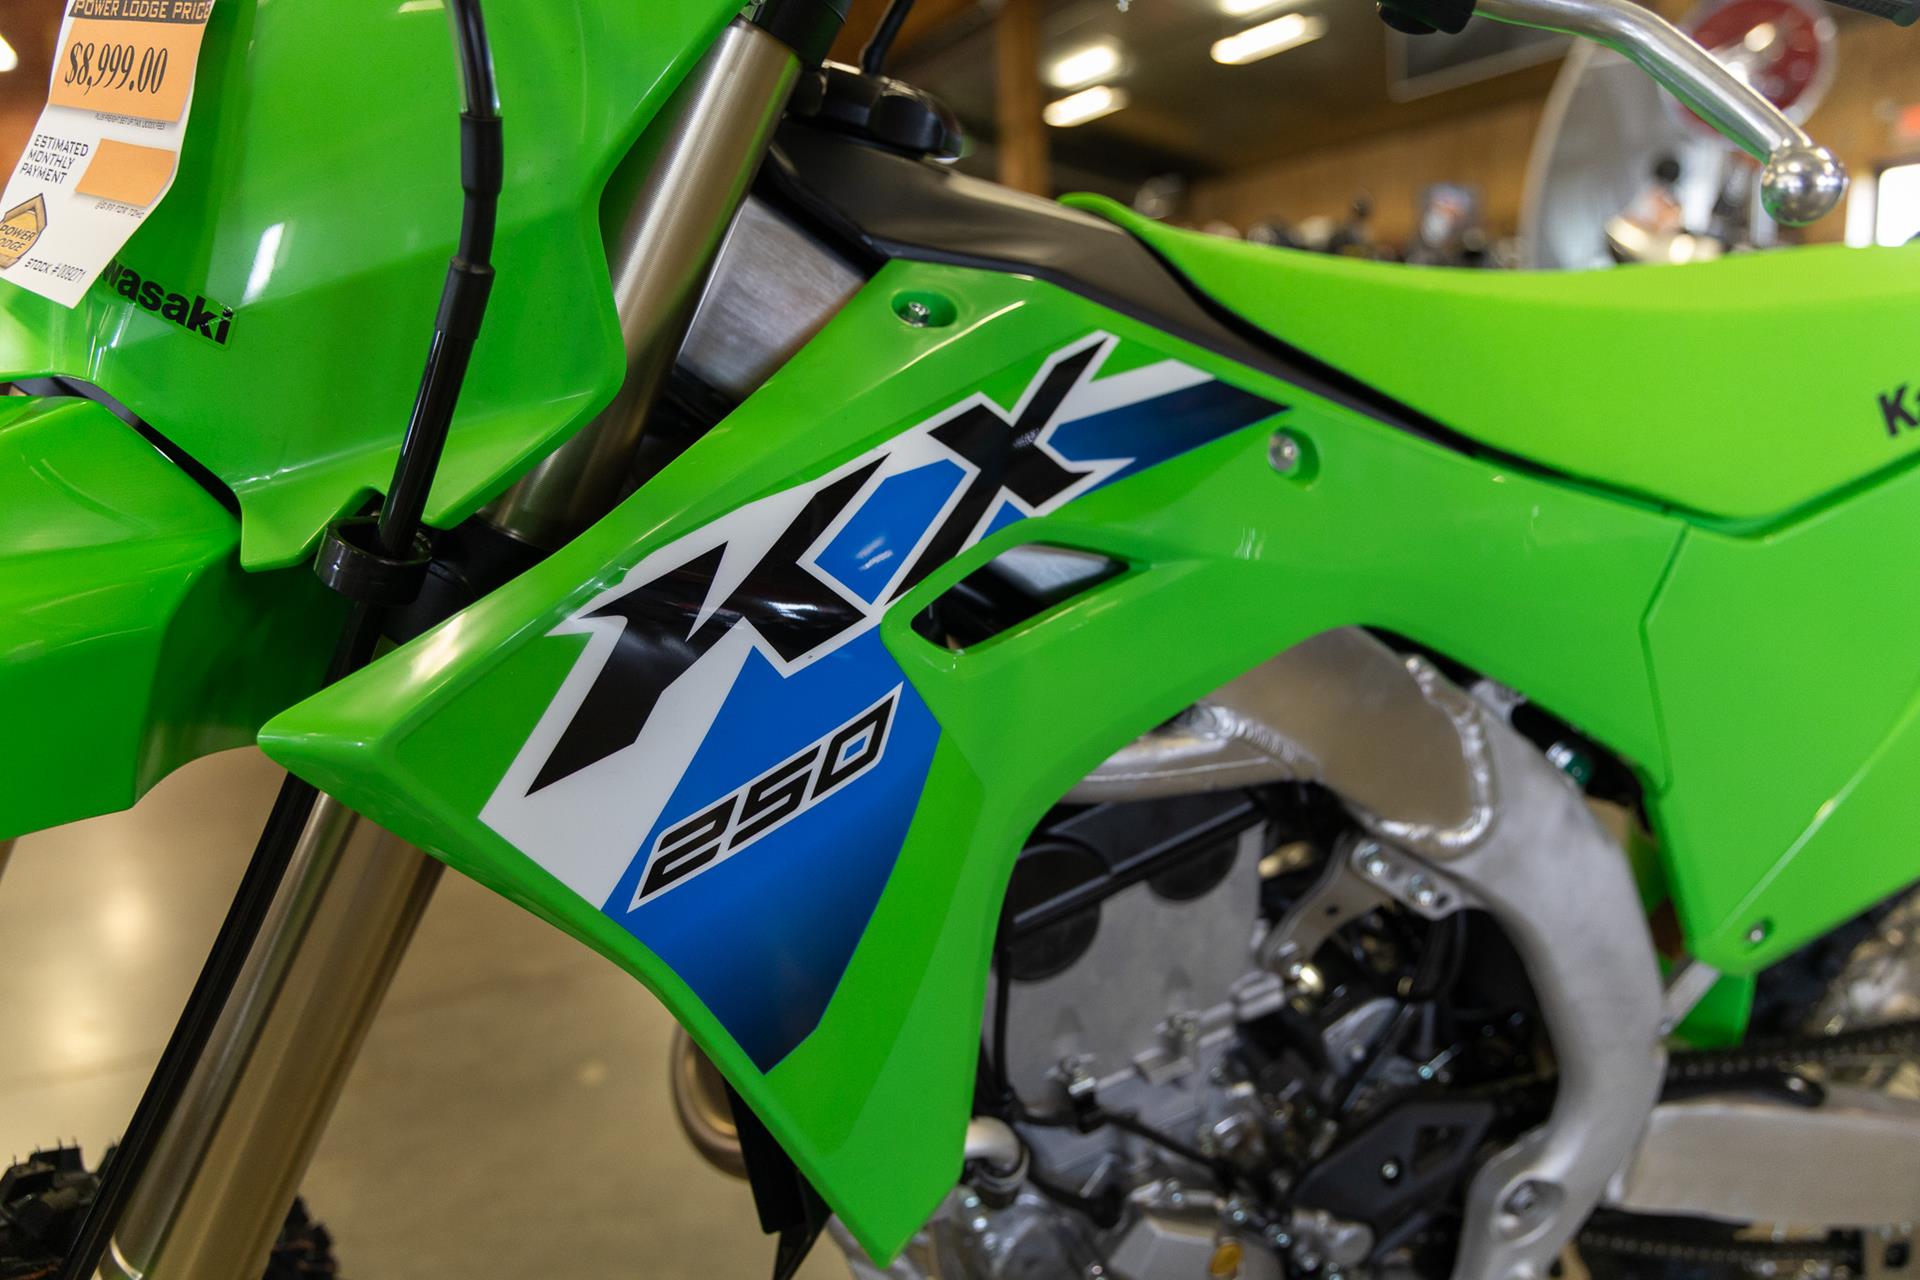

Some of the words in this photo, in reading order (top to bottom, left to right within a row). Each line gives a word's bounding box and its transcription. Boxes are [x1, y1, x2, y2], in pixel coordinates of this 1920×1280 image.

[74, 0, 120, 17] POWER
[122, 1, 169, 19] LODGE
[172, 1, 211, 20] PRICE
[64, 41, 168, 96] $8,999.00
[34, 134, 89, 157] ESTIMATED
[27, 148, 75, 170] MONTHLY
[19, 162, 67, 184] PAYMENT
[0, 224, 37, 242] POWER
[0, 237, 26, 252] ODGE
[24, 258, 54, 274] STOCK
[1878, 384, 1920, 436] K
[525, 334, 1107, 798] KX
[638, 691, 897, 902] 250
